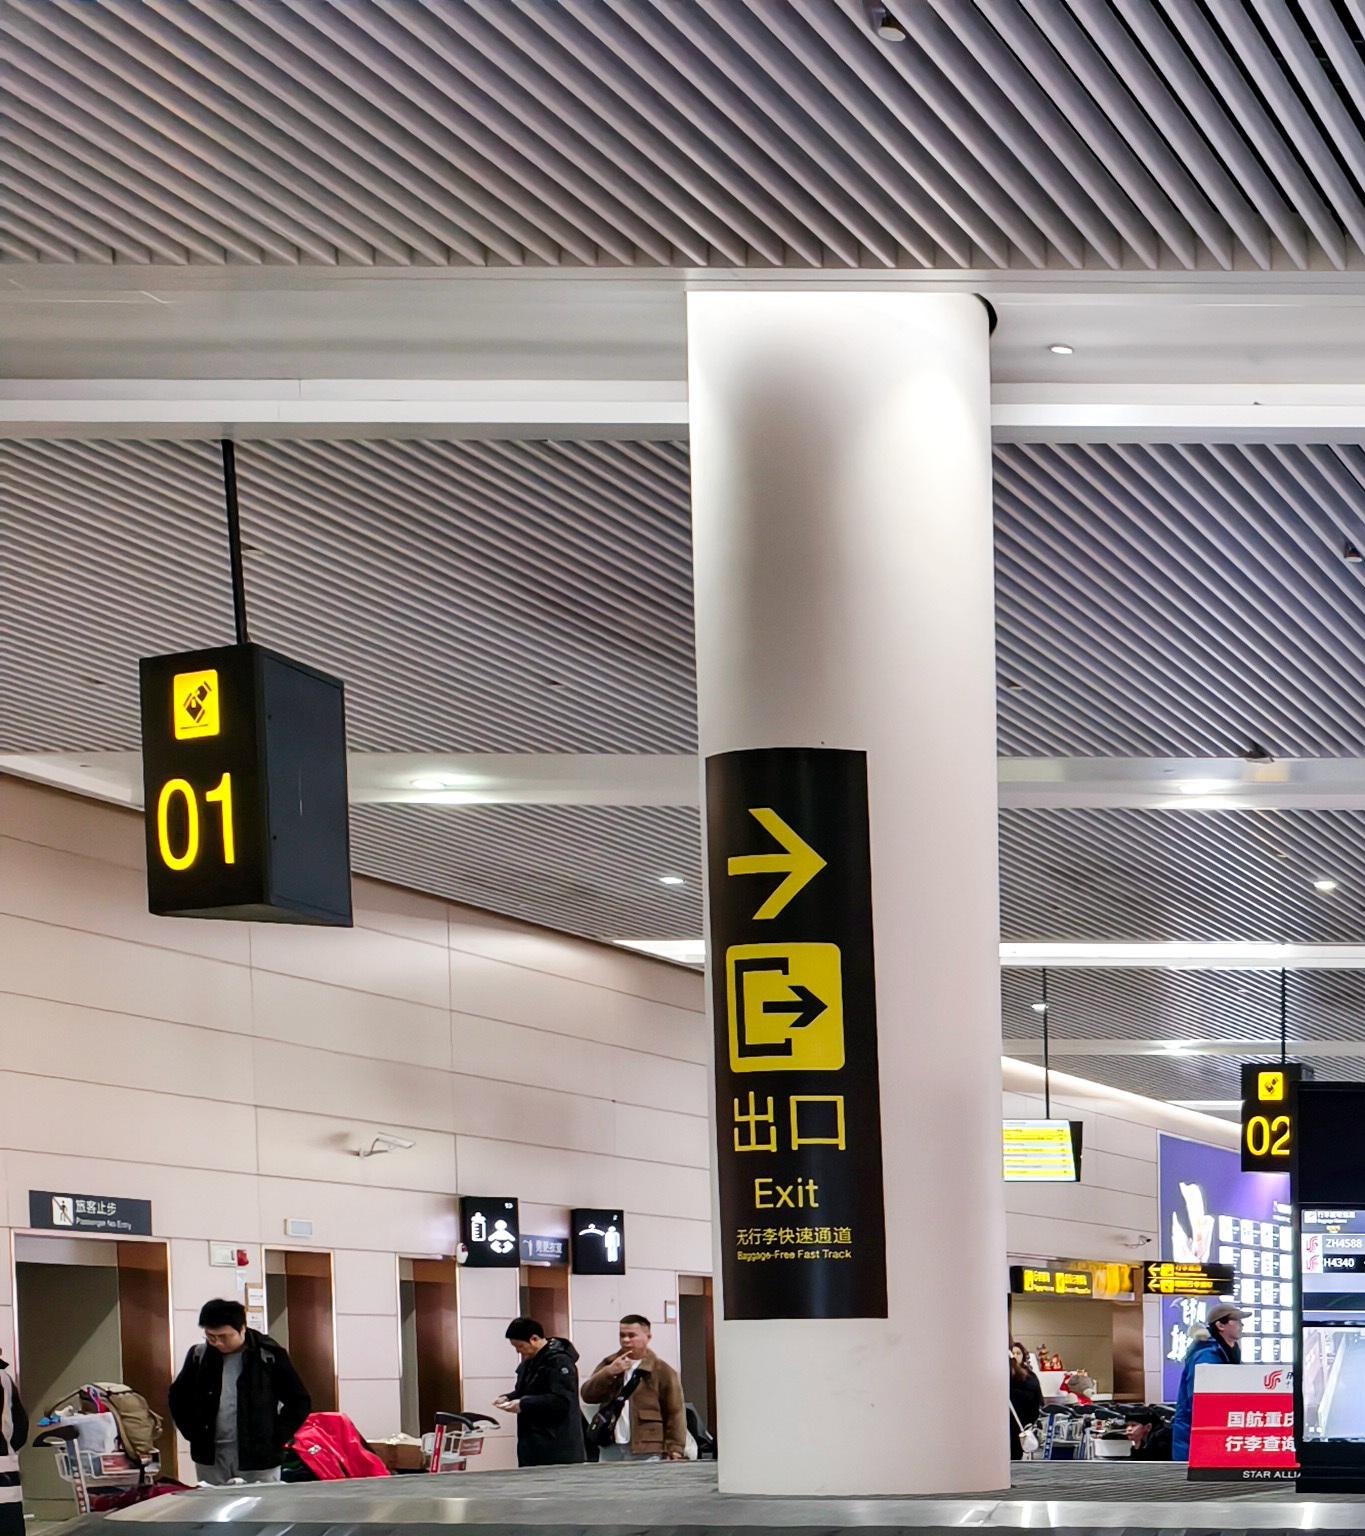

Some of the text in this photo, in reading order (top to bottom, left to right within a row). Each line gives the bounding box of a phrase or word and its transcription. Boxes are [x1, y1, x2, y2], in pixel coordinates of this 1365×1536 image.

[157, 772, 235, 870] 01
[734, 1091, 847, 1153] 出口
[1246, 1115, 1290, 1156] 02
[754, 1177, 819, 1209] Exit
[736, 1227, 852, 1245] 无行李快速通道
[797, 1249, 820, 1259] Fast
[824, 1248, 852, 1259] Track
[1225, 1435, 1296, 1452] 行李查询
[1243, 1470, 1271, 1479] STAR
